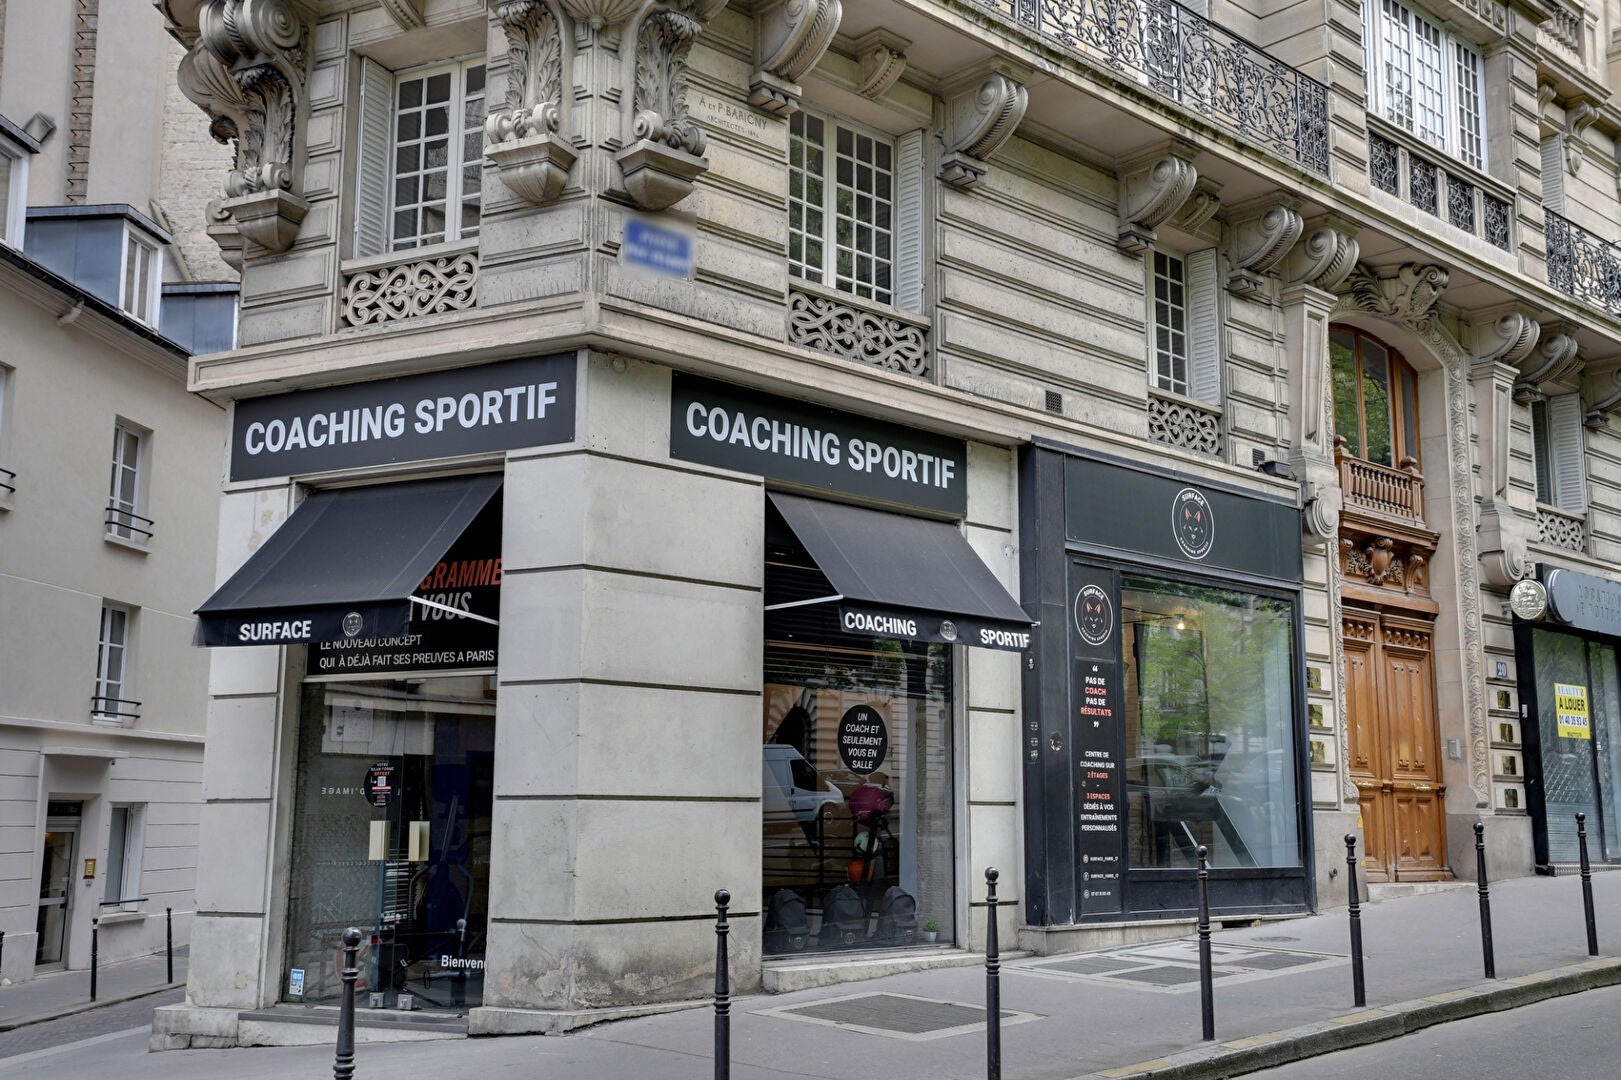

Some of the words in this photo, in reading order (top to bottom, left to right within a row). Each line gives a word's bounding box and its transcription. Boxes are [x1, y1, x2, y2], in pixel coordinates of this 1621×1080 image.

[245, 403, 405, 455] COACHING
[414, 382, 557, 434] SPORTIF
[686, 401, 840, 465] COACHING
[848, 438, 955, 488] SPORTIF
[1182, 492, 1205, 506] SURFACE
[1083, 588, 1104, 600] SURFACE
[421, 591, 472, 621] VOUS
[239, 620, 312, 641] SURFACE
[844, 612, 917, 636] COACHING
[980, 628, 1030, 648] SPORTIF
[320, 641, 331, 650] LE
[333, 638, 377, 650] NOUVEAU
[378, 634, 423, 647] CONCEPT
[319, 657, 335, 668] QUI
[339, 653, 346, 667] À
[347, 653, 371, 667] DÉJÀ
[372, 654, 392, 666] FAIT
[393, 653, 411, 665] SES
[412, 651, 455, 664] PREUVES
[457, 651, 465, 662] A
[466, 649, 495, 662] PARIS
[1085, 676, 1097, 684] PAS
[1085, 687, 1107, 695] COACH
[1086, 697, 1097, 705] PAS
[1098, 698, 1106, 706] DE
[1565, 698, 1585, 711] LOUER
[857, 713, 868, 721] UN
[1080, 706, 1111, 717] RÉSULTATS
[845, 724, 870, 733] COACH
[870, 725, 880, 734] ET
[842, 735, 883, 746] SEULEMENT
[848, 748, 867, 757] VOUS
[867, 749, 877, 758] EN
[852, 760, 873, 769] SALLE
[1091, 771, 1108, 779] ÉTAGES
